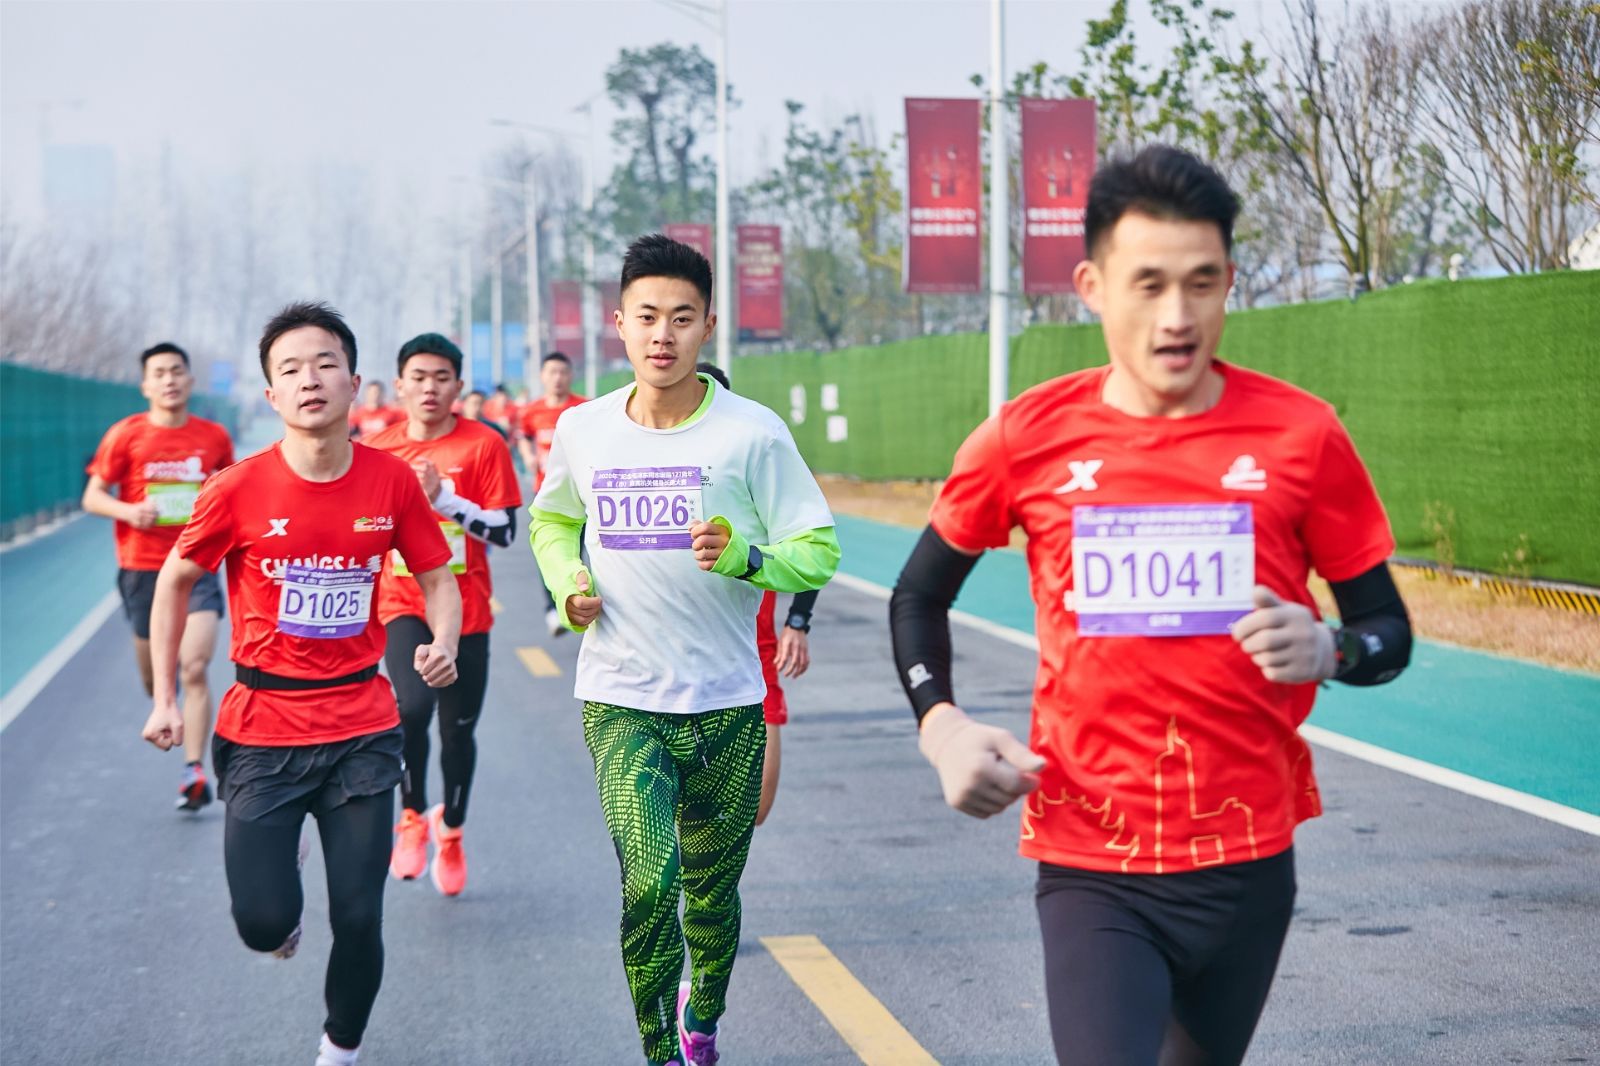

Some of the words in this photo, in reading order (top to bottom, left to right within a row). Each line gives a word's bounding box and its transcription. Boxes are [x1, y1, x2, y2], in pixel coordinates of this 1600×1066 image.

[597, 495, 689, 527] D1026
[1083, 551, 1224, 598] D1041
[284, 588, 360, 618] D1025
